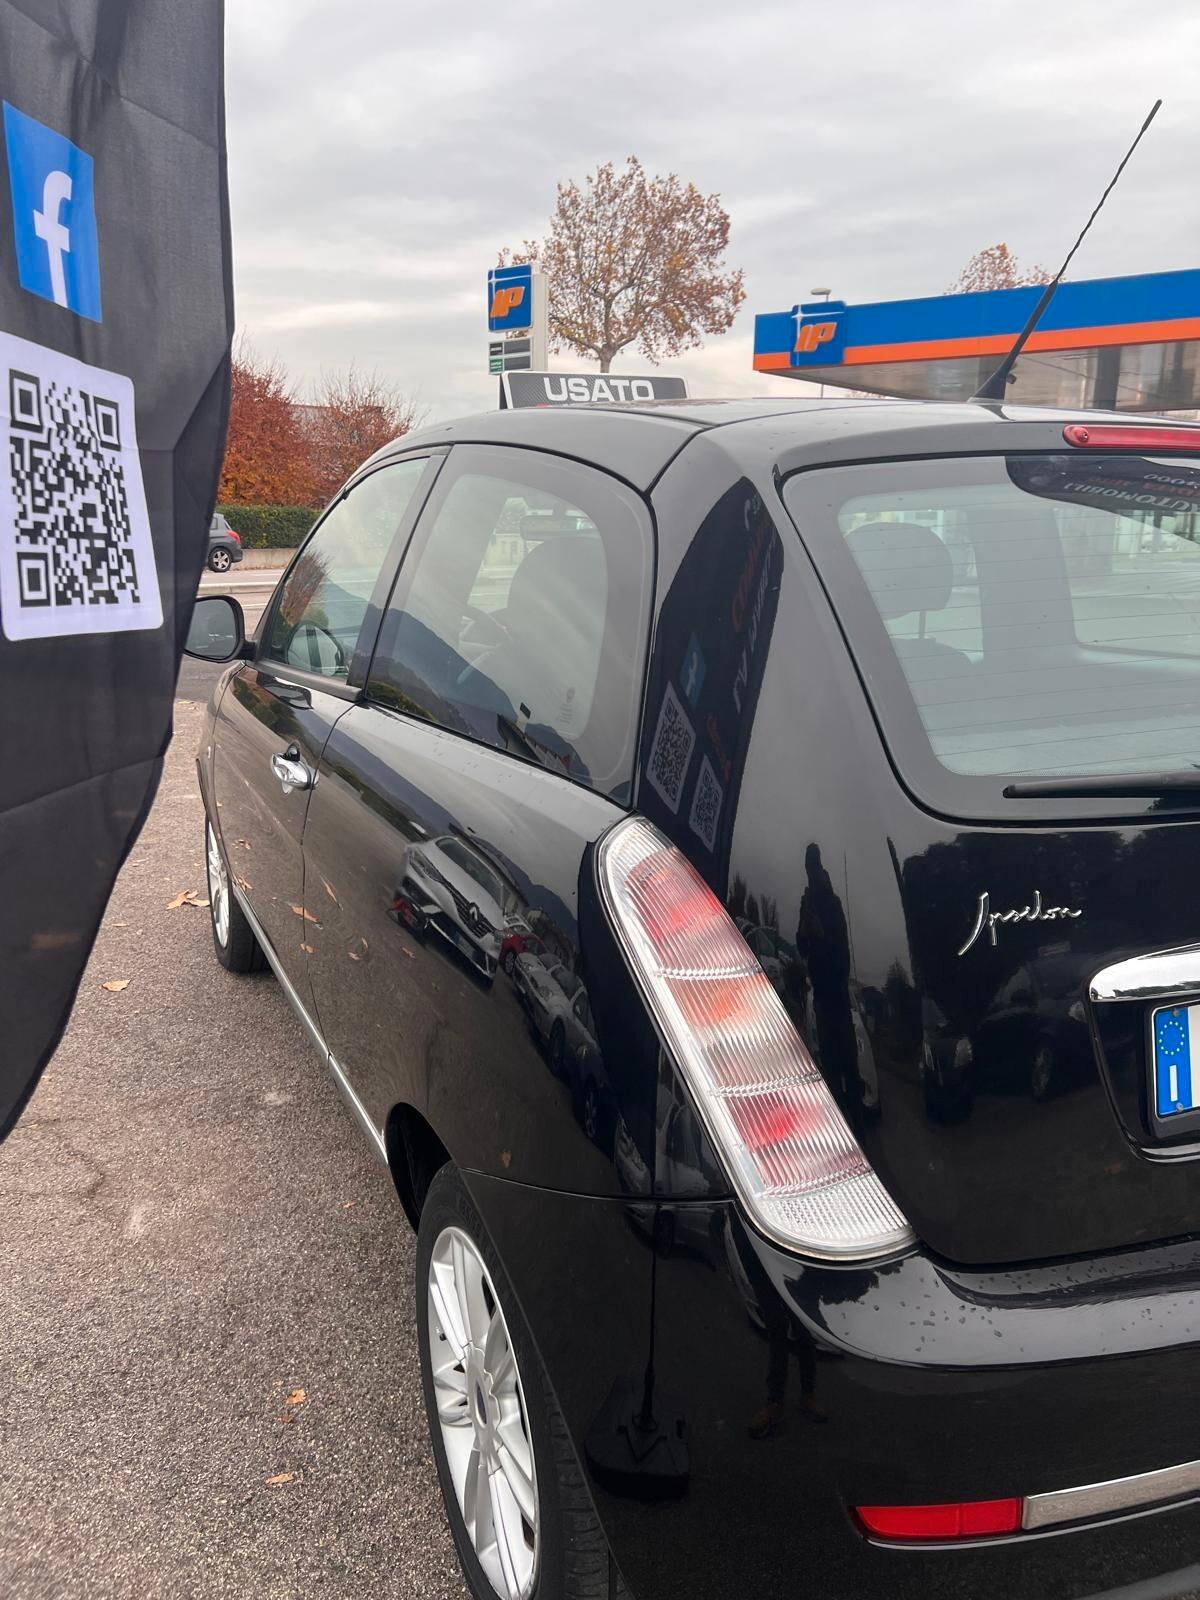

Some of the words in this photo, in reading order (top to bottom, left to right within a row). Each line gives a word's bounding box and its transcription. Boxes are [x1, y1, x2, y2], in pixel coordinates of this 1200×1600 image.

[33, 170, 72, 309] f
[543, 376, 655, 402] USATO
[958, 890, 1082, 956] Ypsilon
[1169, 1064, 1179, 1102] I
